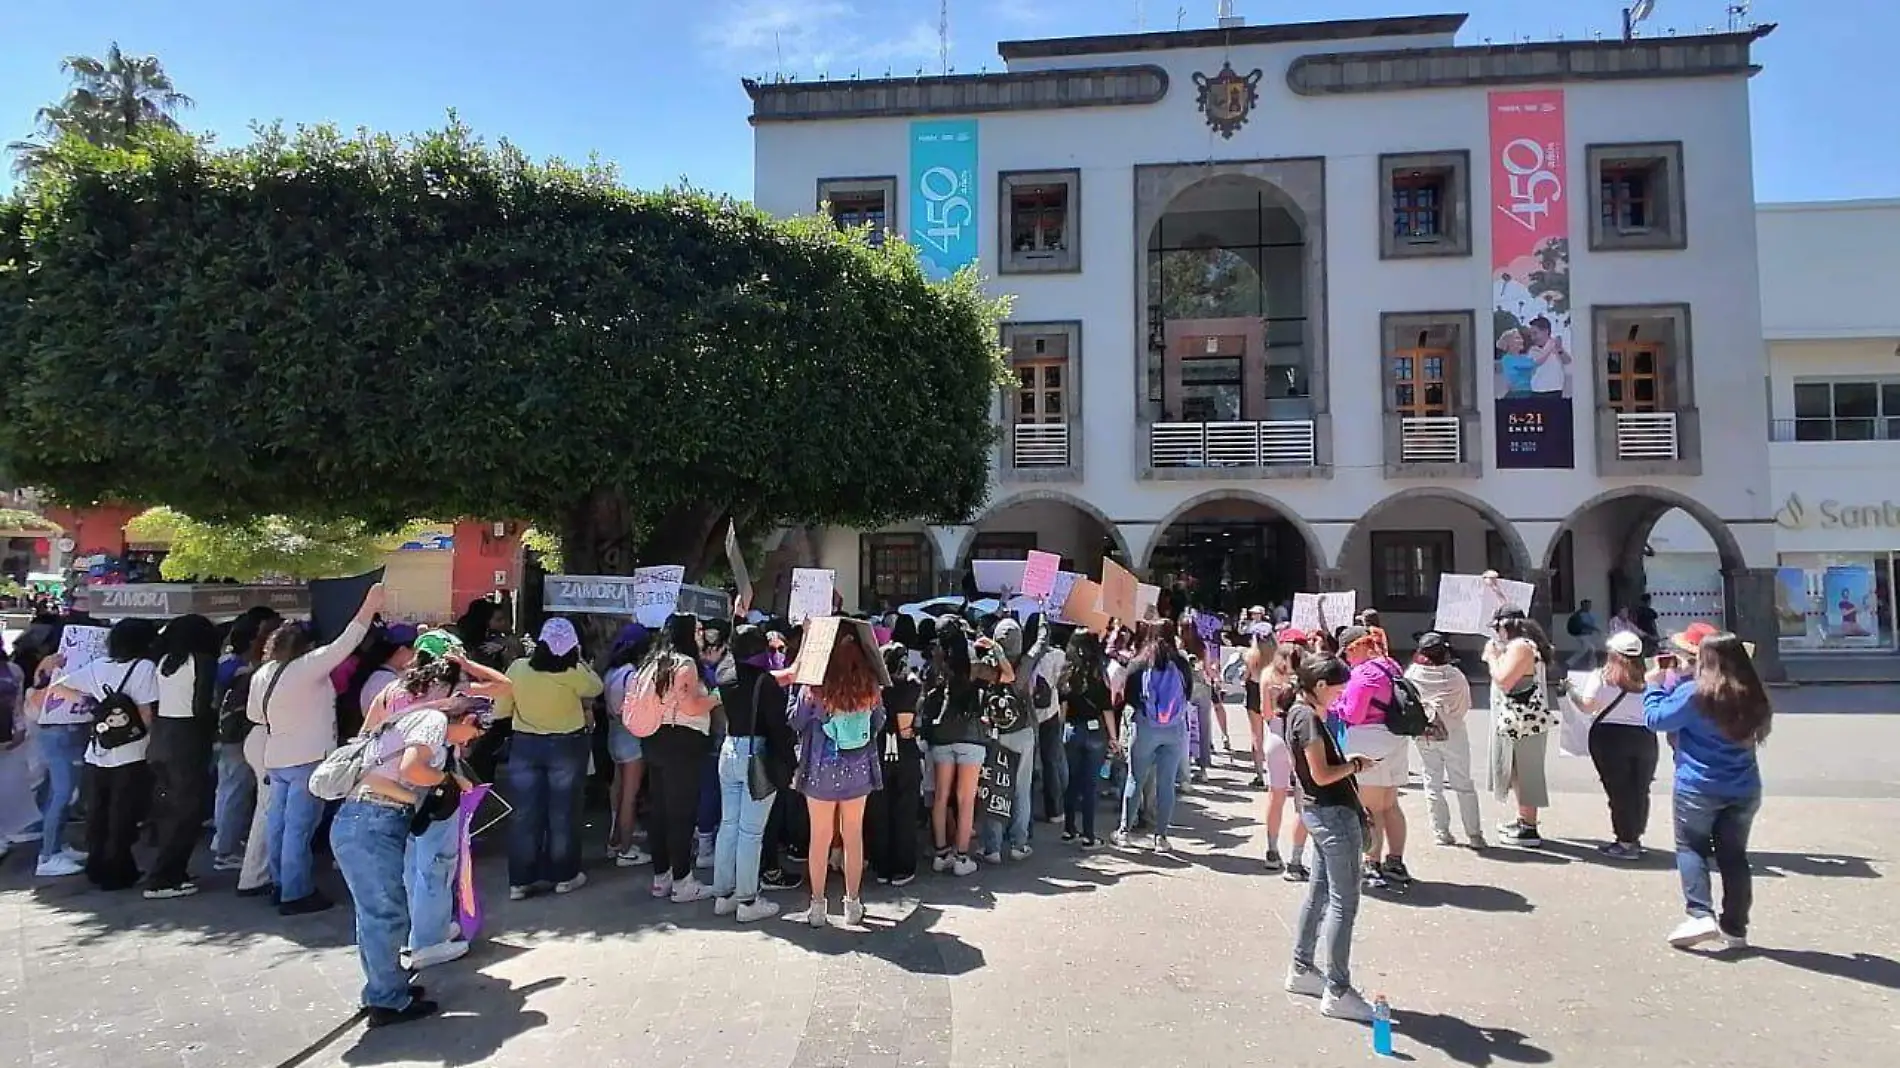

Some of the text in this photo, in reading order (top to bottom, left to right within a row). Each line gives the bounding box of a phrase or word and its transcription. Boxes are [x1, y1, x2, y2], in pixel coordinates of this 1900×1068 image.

[915, 166, 972, 253] 450
[1497, 138, 1561, 231] 450
[102, 592, 169, 614] ZAMORA
[559, 583, 629, 609] ZAMORA
